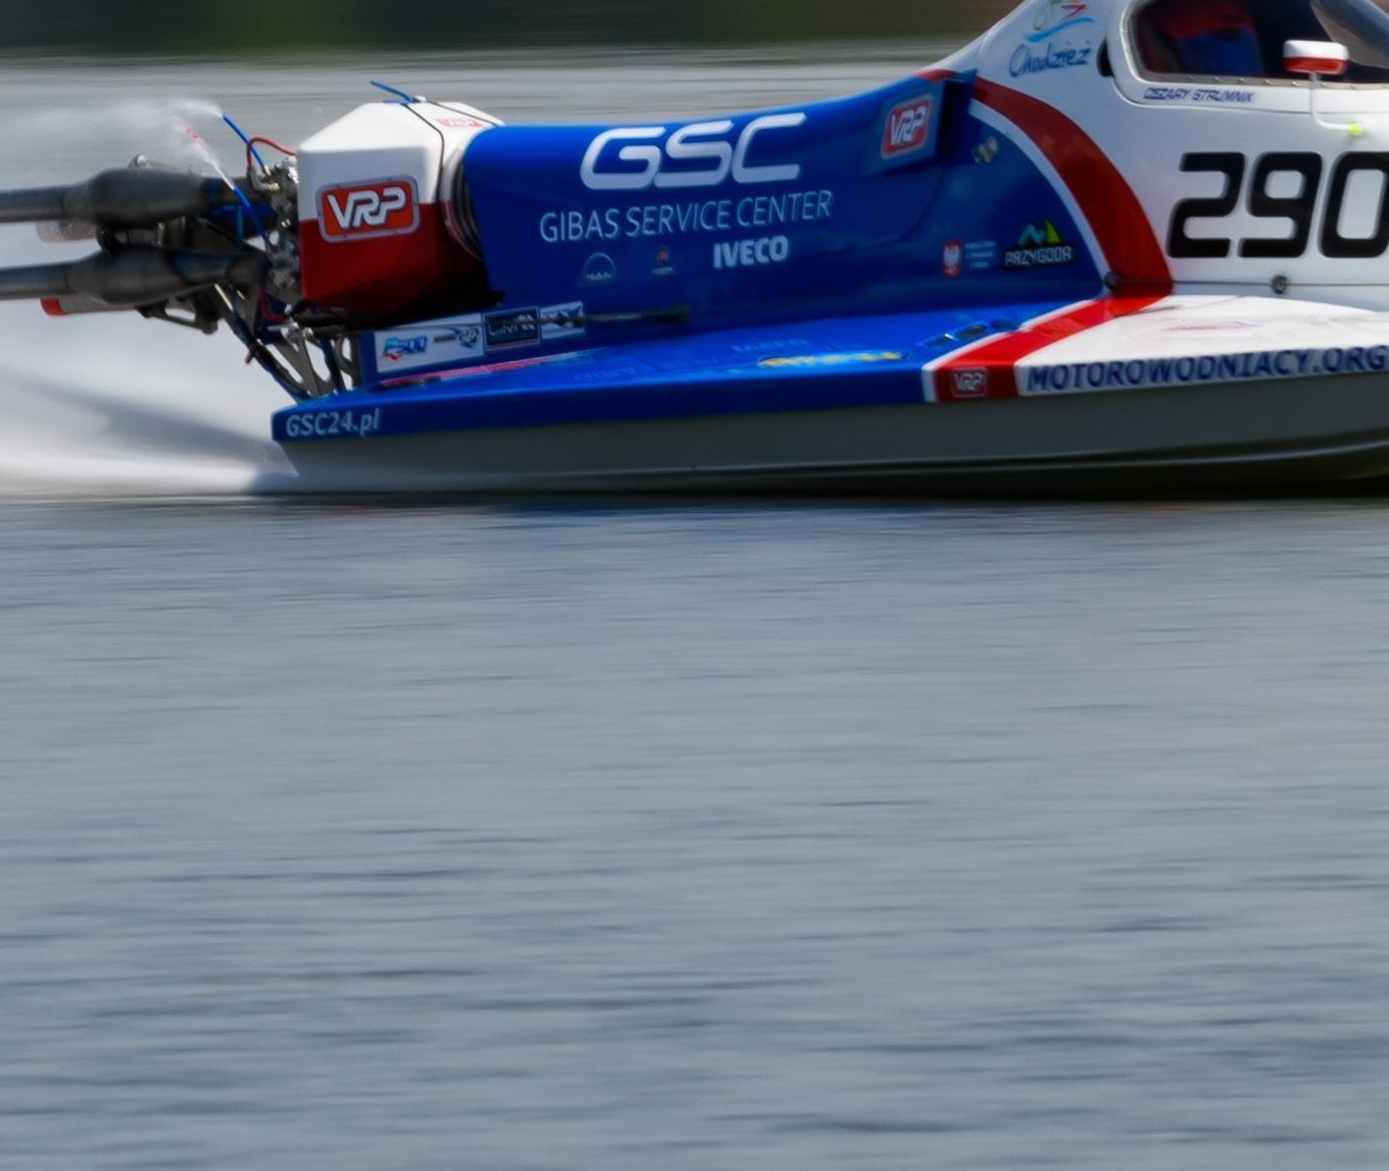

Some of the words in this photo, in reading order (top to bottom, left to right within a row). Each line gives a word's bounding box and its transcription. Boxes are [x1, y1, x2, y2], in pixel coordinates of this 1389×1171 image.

[889, 105, 927, 147] VRP
[580, 112, 807, 190] GSC
[326, 186, 406, 230] VRP
[539, 208, 619, 242] GIBAS
[624, 199, 733, 237] SERVICE
[735, 189, 833, 227] CENTER
[713, 235, 789, 268] IVECO
[1004, 245, 1073, 267] PRZYGODA
[1027, 344, 1389, 392] MOTOROWODNIACY.ORG
[286, 407, 380, 437] GSC24.pl
